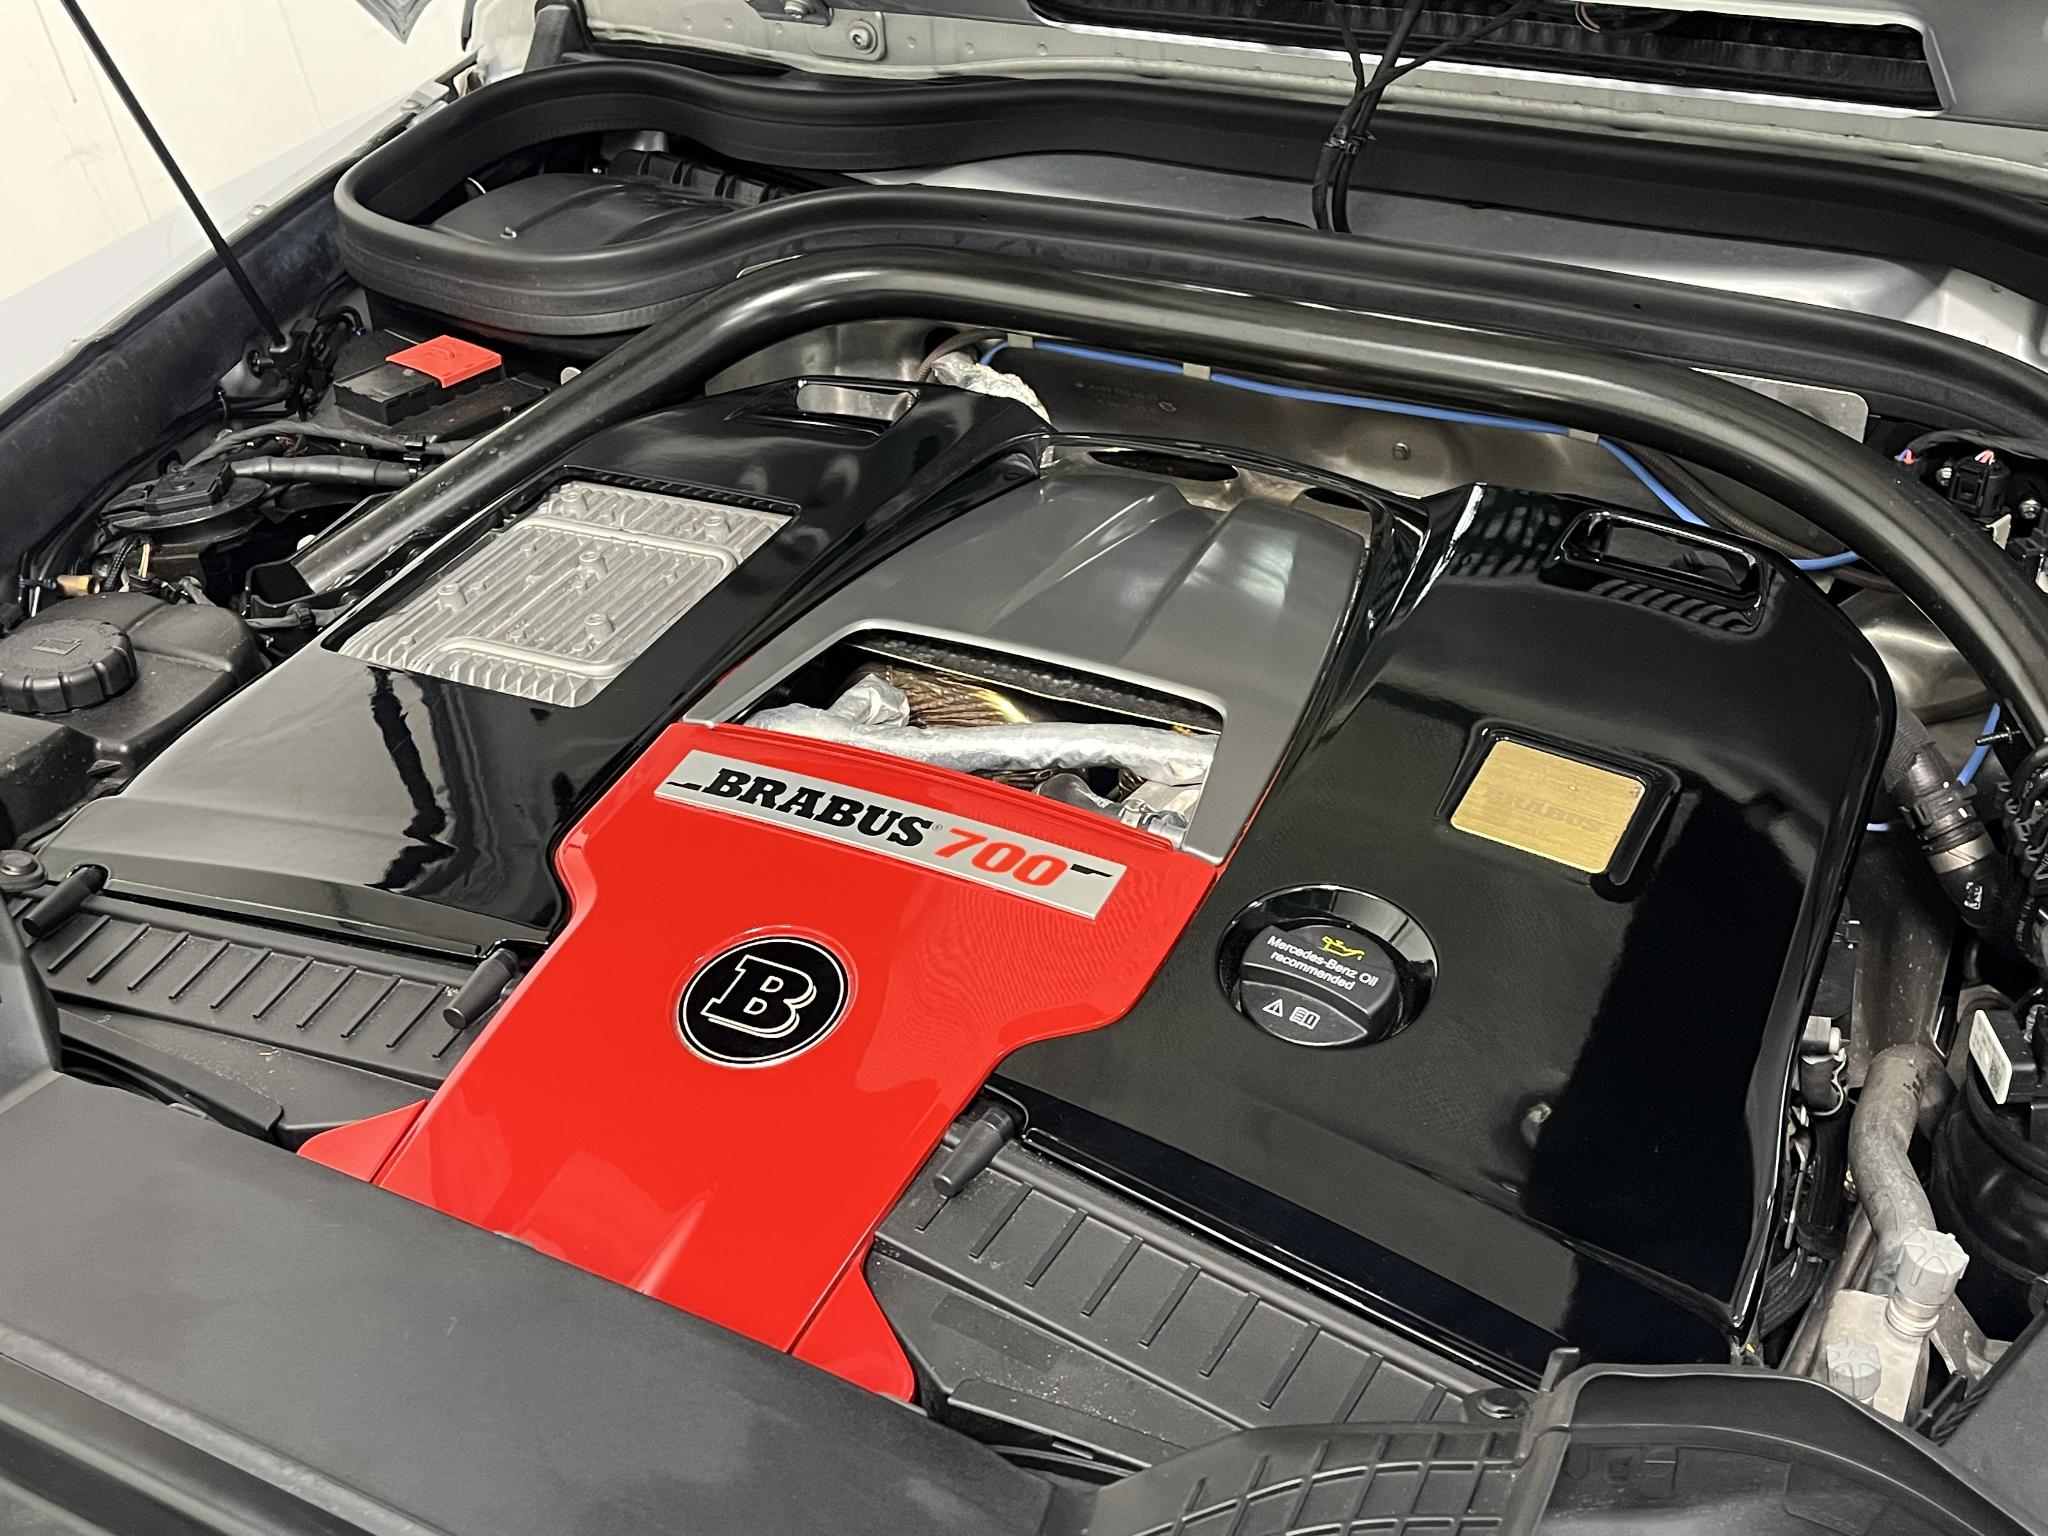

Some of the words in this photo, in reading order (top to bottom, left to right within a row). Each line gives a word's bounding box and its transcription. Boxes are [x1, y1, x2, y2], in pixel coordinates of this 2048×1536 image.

[934, 827, 1069, 886] 700
[1267, 935, 1358, 979] Mercedes-Benz
[1358, 972, 1378, 987] Oil
[1270, 951, 1355, 991] recommended
[700, 954, 817, 1038] B
